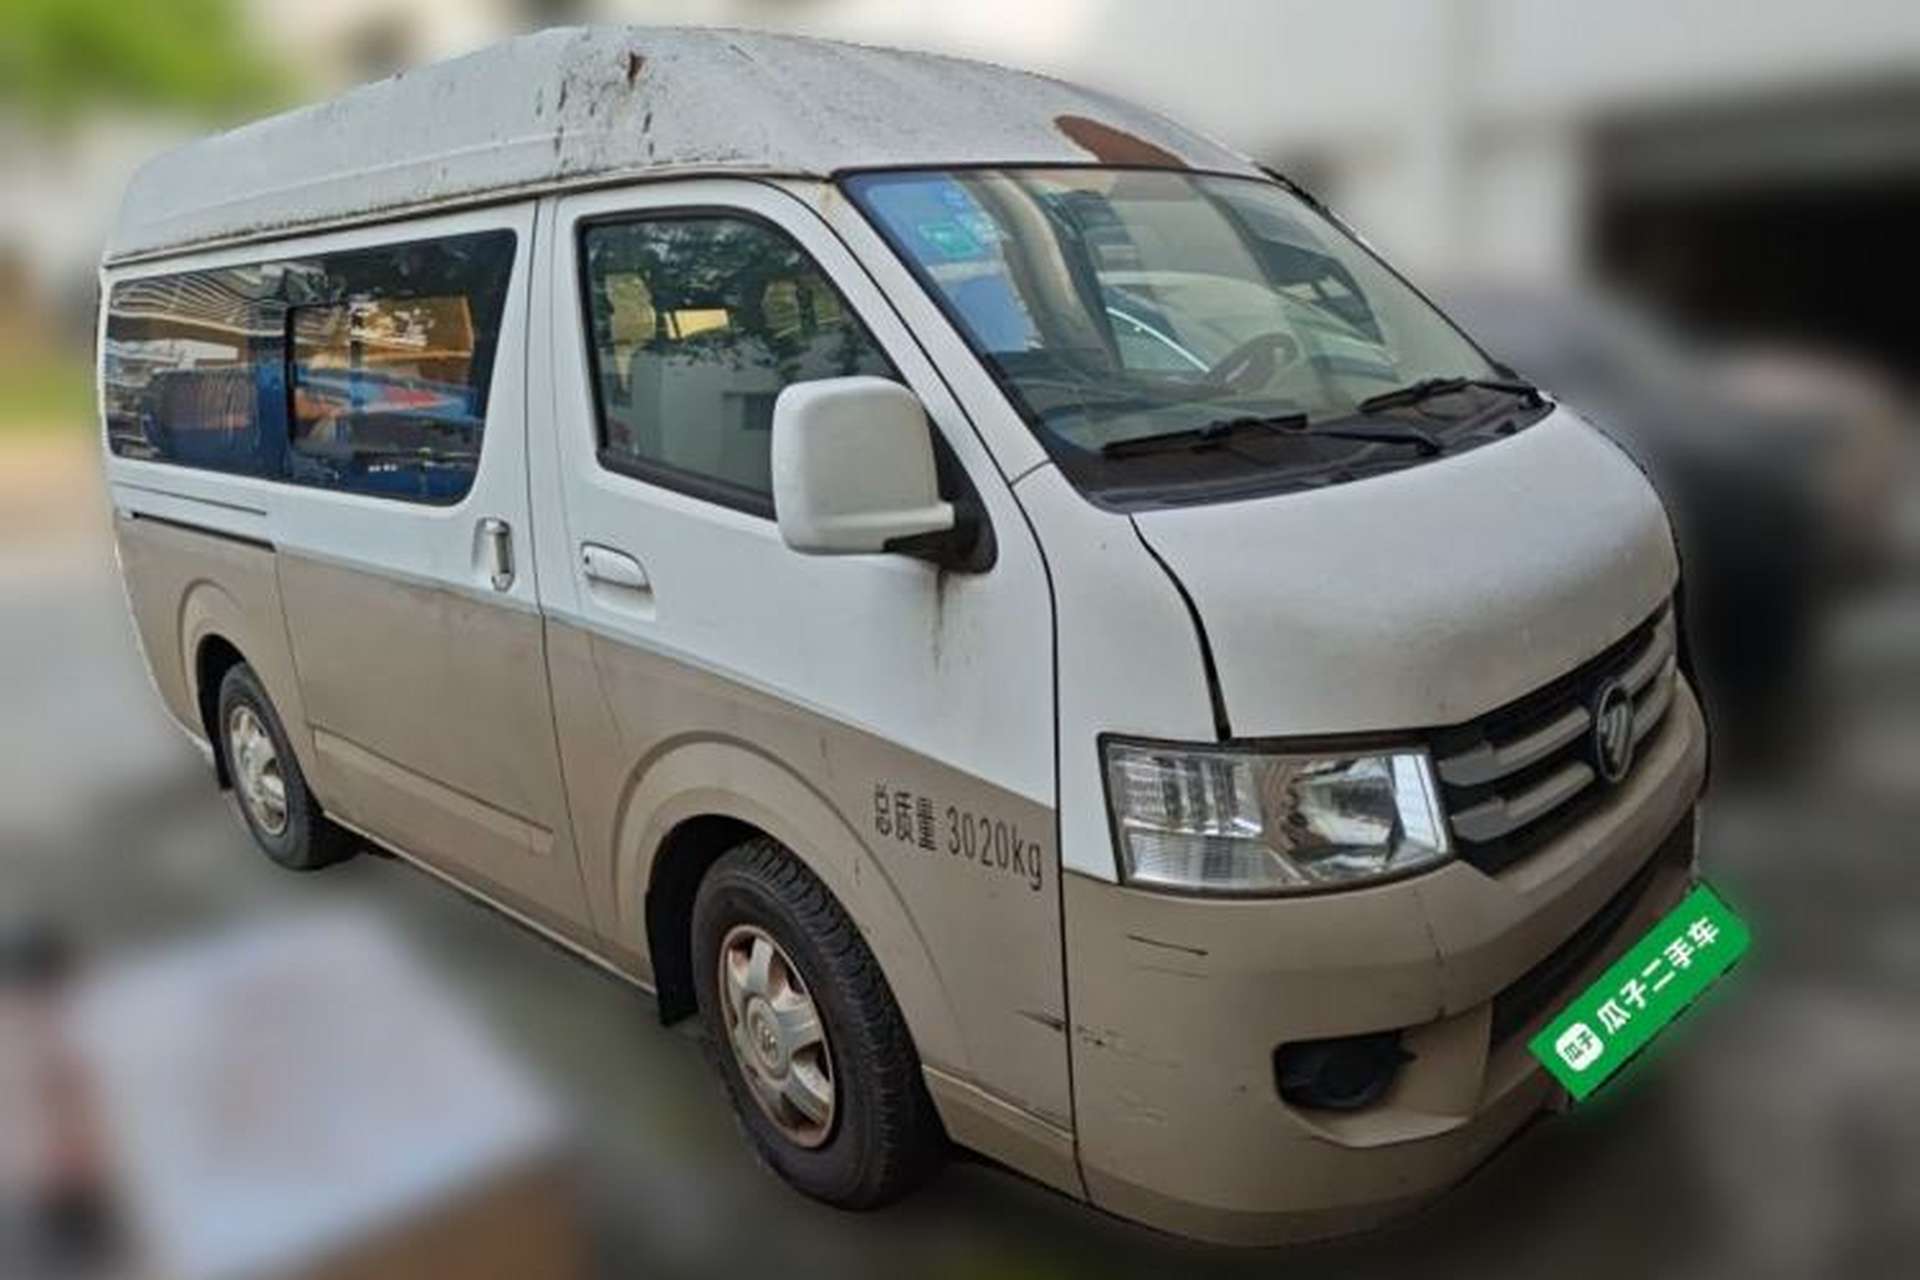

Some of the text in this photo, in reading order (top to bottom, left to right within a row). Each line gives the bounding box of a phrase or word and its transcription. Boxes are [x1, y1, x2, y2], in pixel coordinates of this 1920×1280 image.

[875, 780, 1042, 891] 总质量 3020kg
